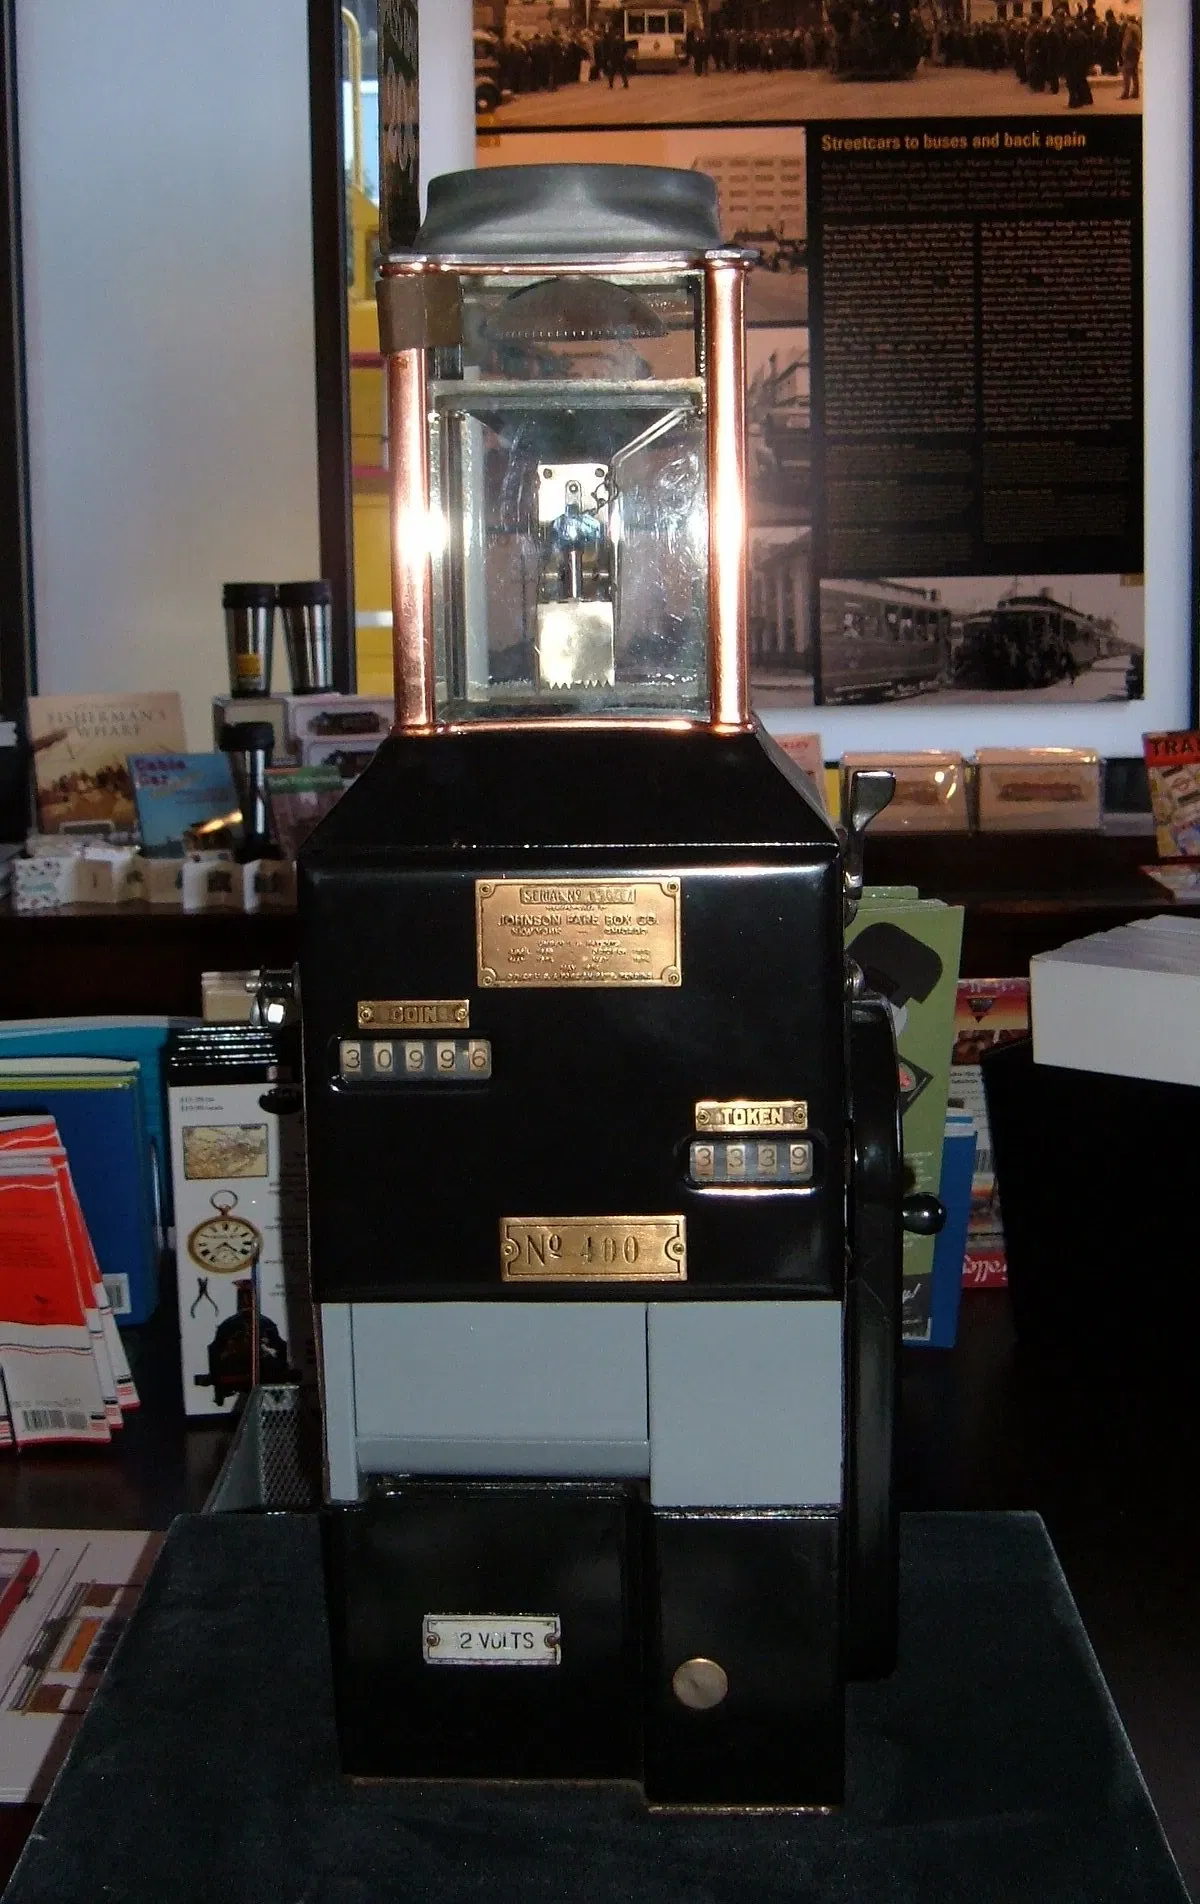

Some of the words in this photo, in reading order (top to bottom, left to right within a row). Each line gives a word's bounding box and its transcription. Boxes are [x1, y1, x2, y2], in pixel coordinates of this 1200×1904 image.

[821, 135, 900, 151] Streetcars
[905, 135, 919, 149] to
[923, 133, 968, 149] buses
[972, 132, 1000, 148] and
[1004, 131, 1040, 148] back
[1045, 132, 1086, 149] again
[498, 914, 561, 927] JOHNSON
[566, 914, 599, 926] FARE
[604, 914, 632, 926] BOX
[393, 1005, 437, 1022] COIN
[721, 1107, 784, 1125] TOKEN
[460, 1632, 472, 1649] 2
[478, 1632, 534, 1649] VOLTS
